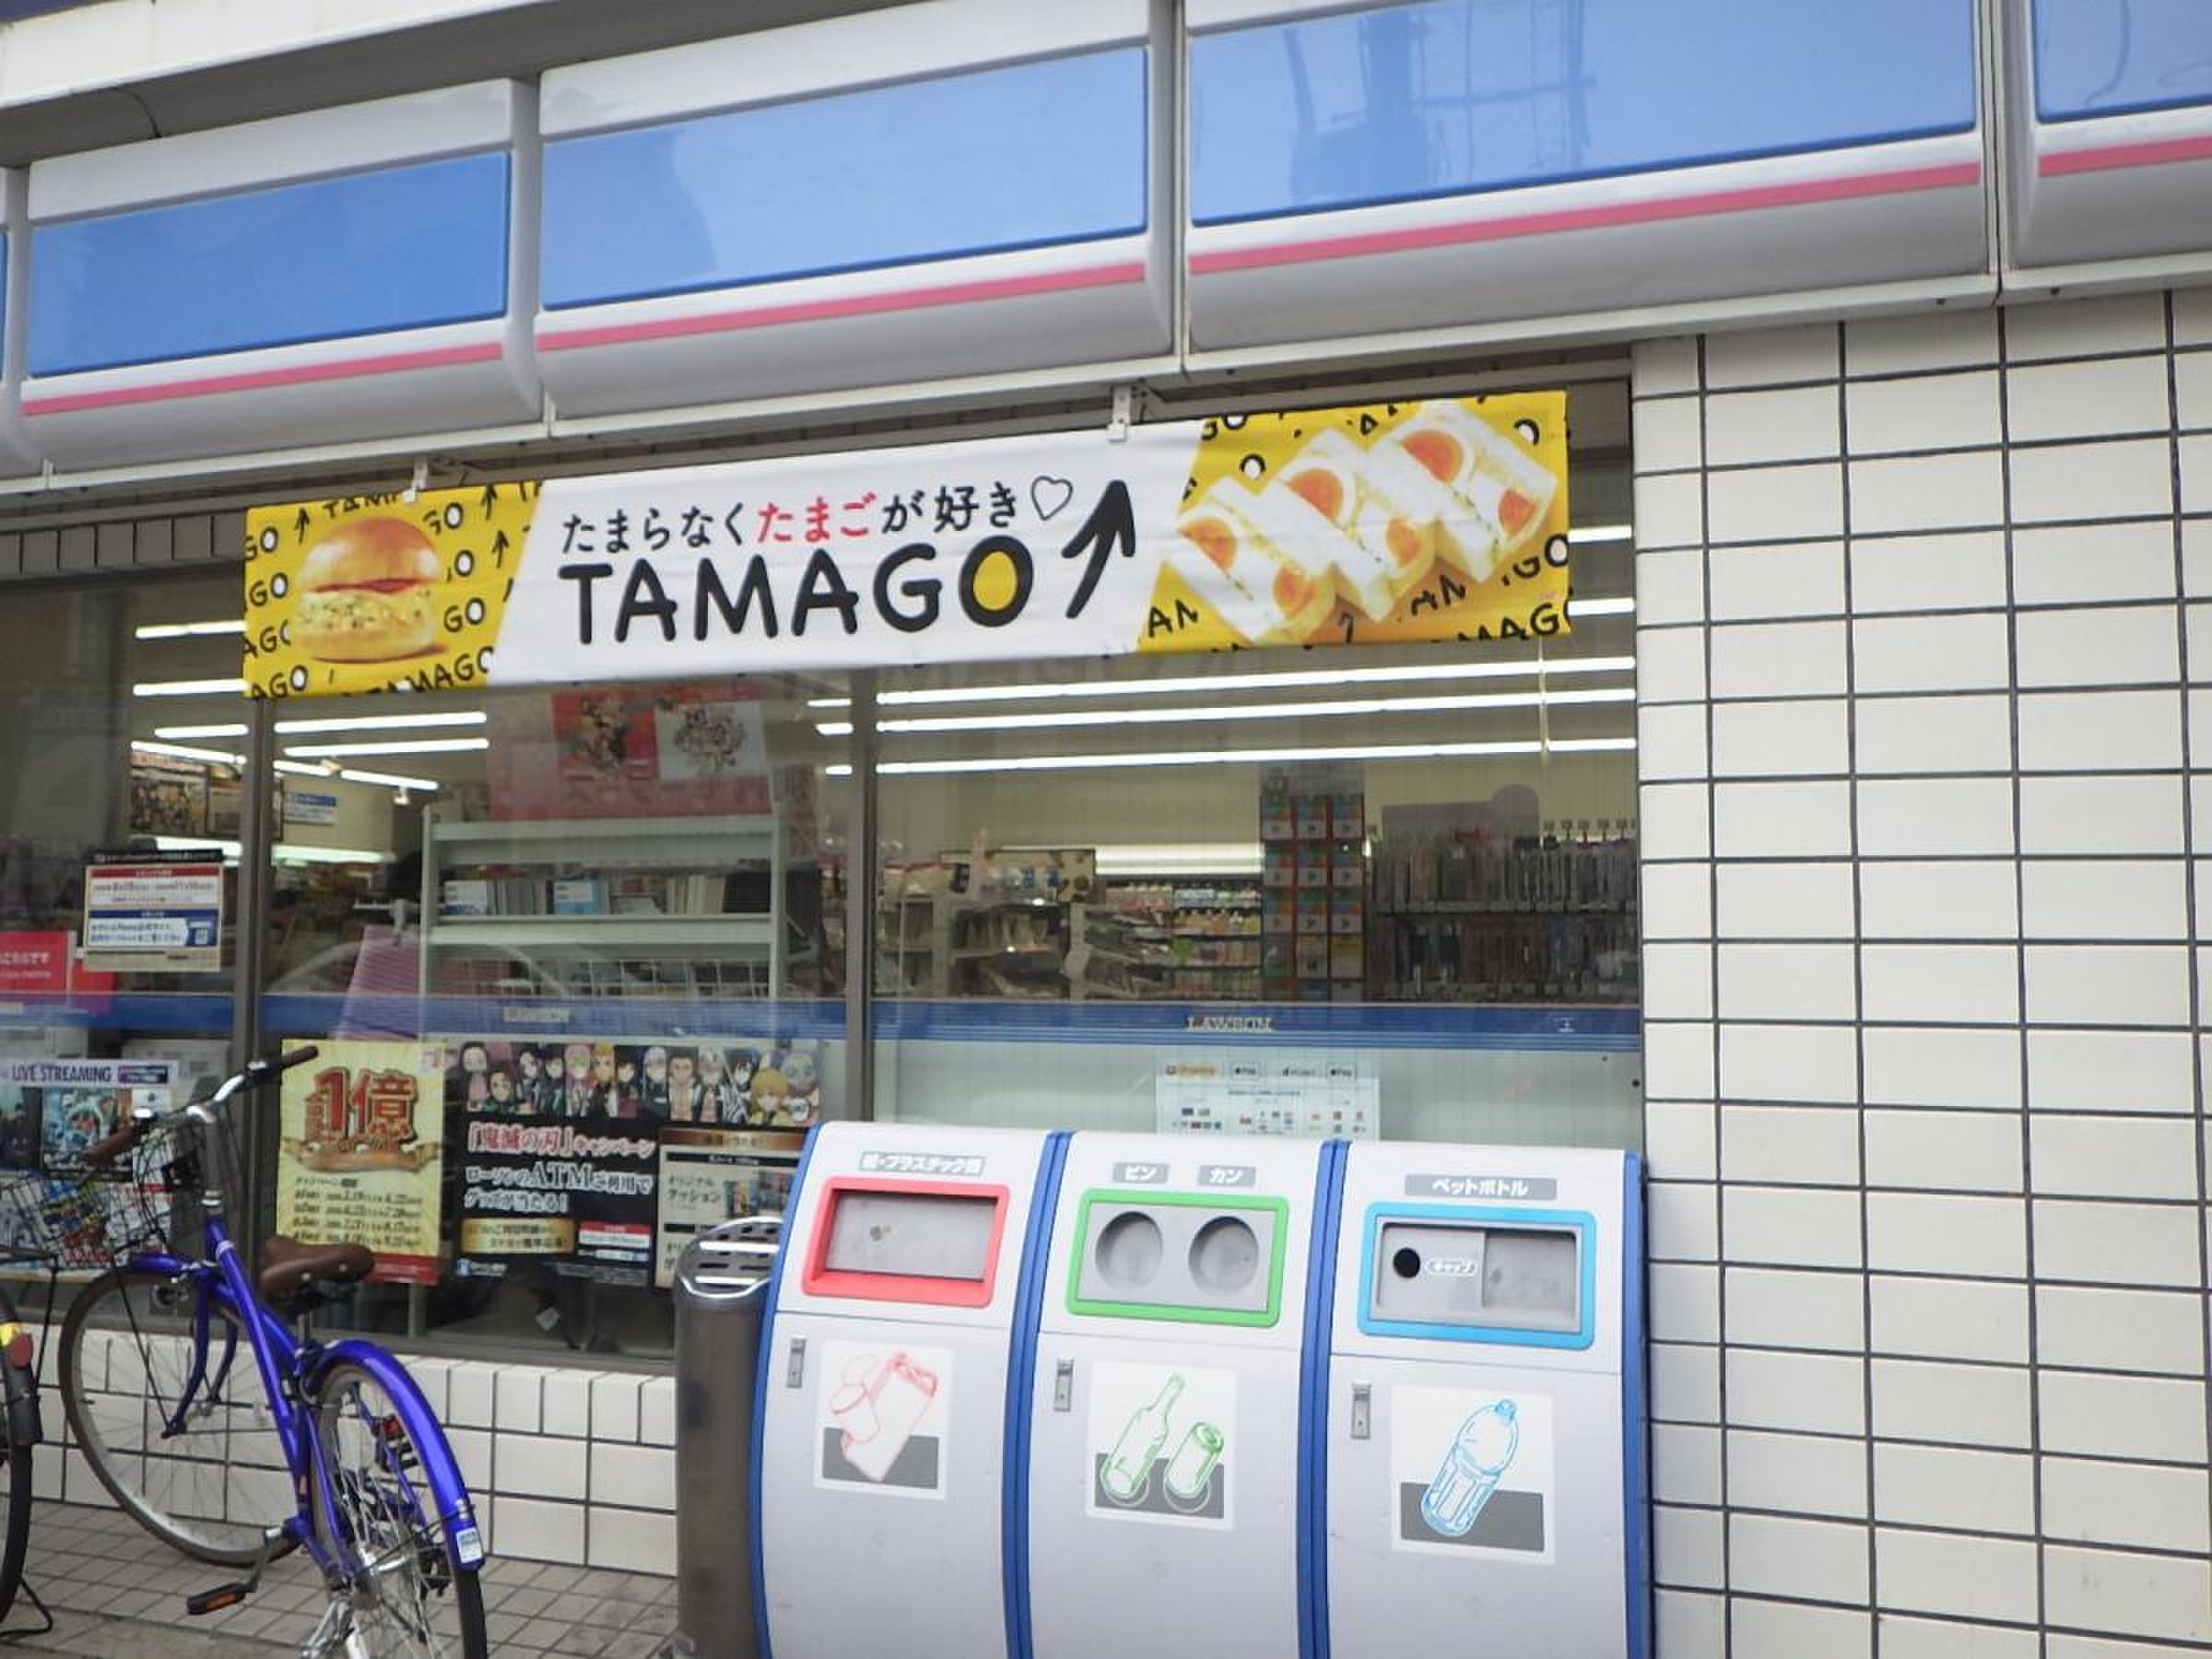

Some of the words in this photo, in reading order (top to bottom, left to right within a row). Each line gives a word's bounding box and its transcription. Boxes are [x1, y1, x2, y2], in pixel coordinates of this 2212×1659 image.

[562, 480, 1017, 554] たまらなくたまごが好き
[1500, 533, 1568, 586] GO
[558, 535, 1034, 645] TAMAGO
[443, 597, 486, 632] GO
[41, 1063, 112, 1084] STREAMING
[1431, 1178, 1530, 1197] ペットボトル
